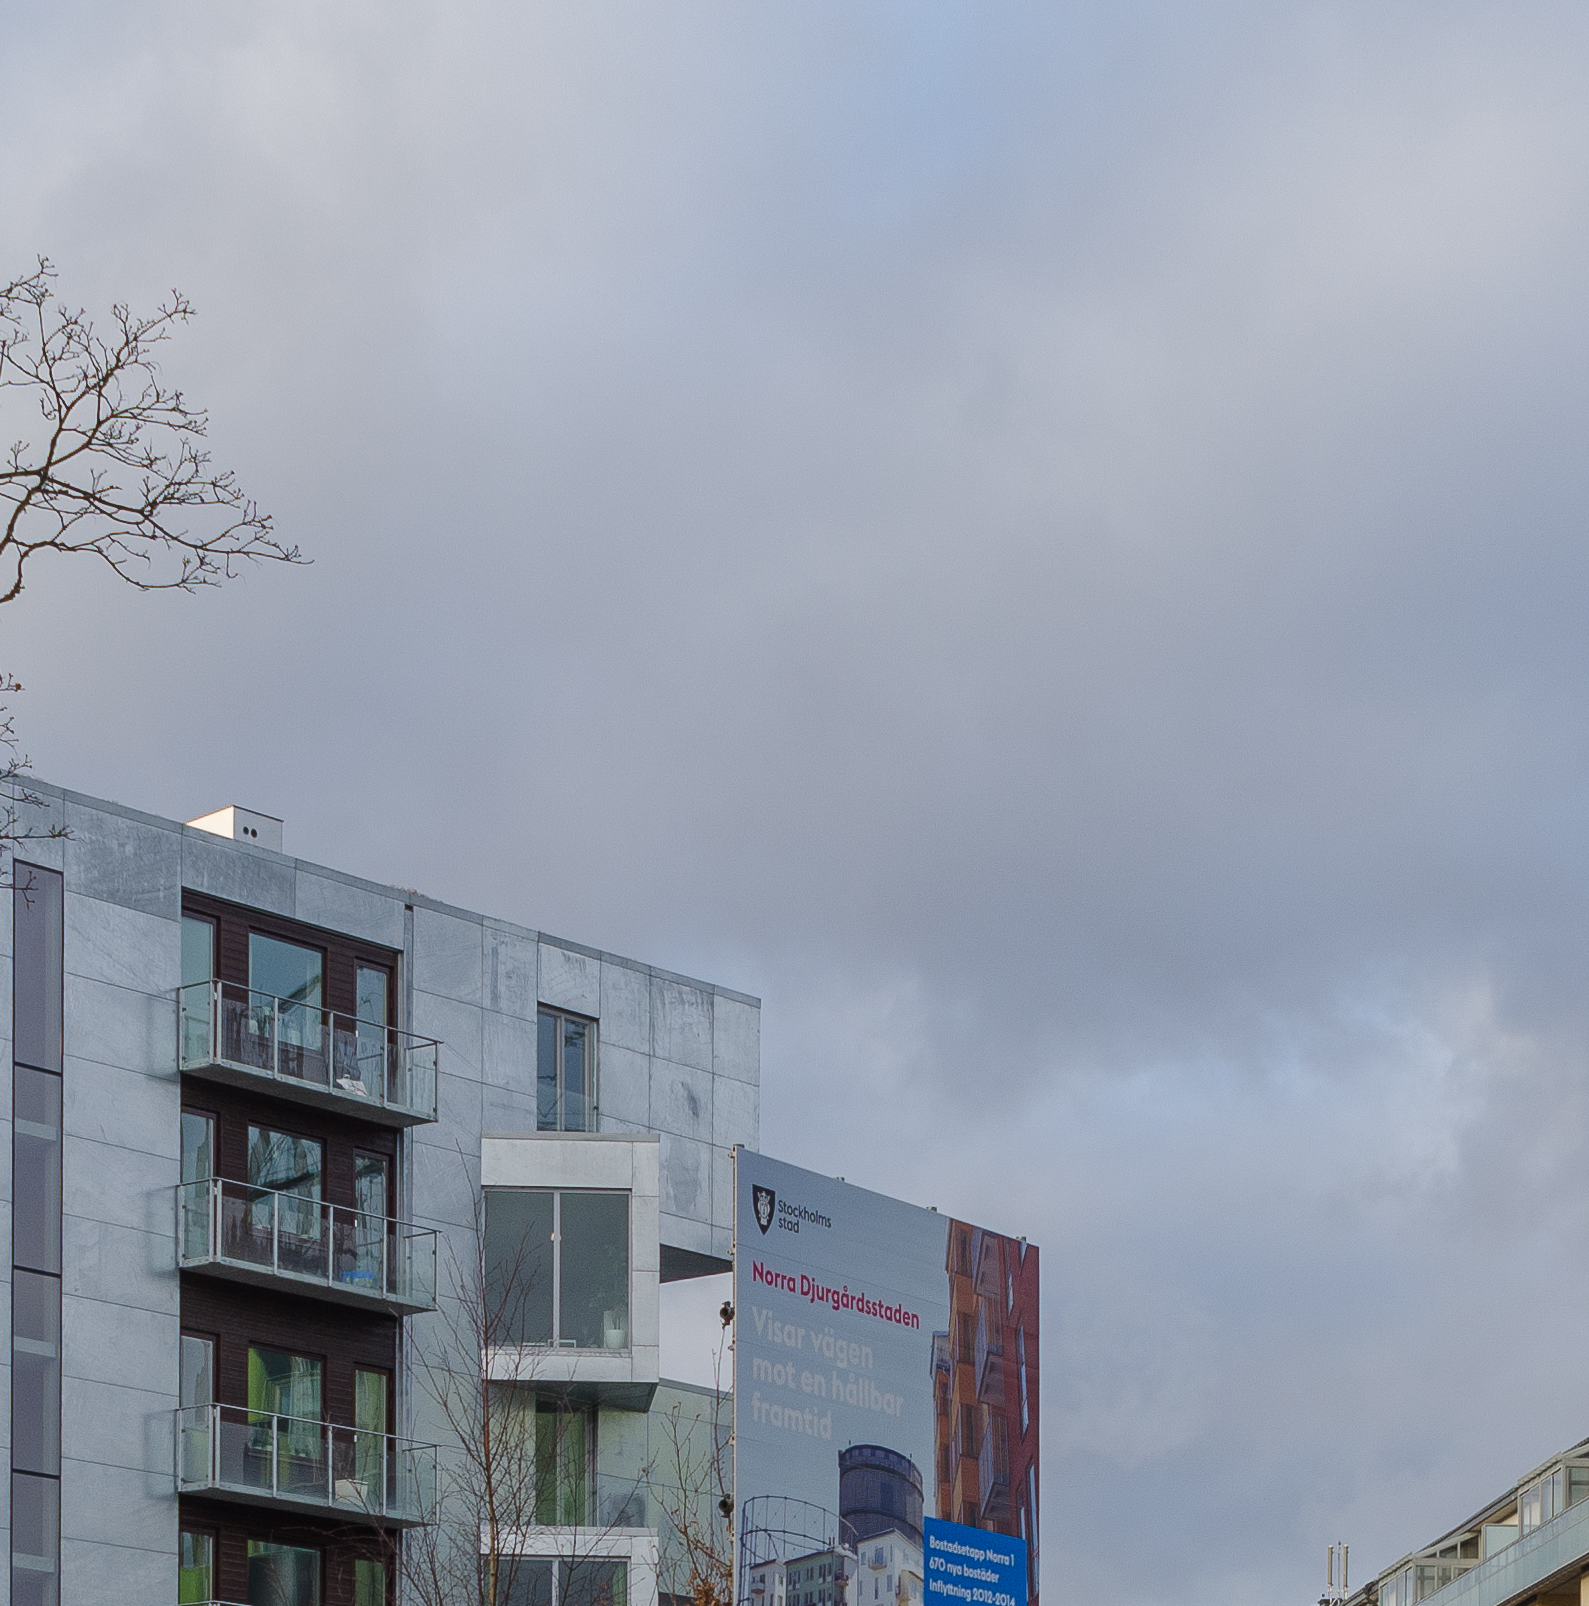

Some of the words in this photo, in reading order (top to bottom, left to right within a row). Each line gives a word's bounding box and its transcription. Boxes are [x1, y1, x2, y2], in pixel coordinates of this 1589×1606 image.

[777, 1199, 832, 1229] Stockholms
[777, 1217, 800, 1234] stad
[751, 1261, 796, 1294] Norra
[800, 1274, 920, 1330] Djurgårdsstaden
[751, 1307, 805, 1349] Visar
[810, 1326, 875, 1370] vägen
[752, 1355, 794, 1391] mot
[801, 1370, 827, 1397] en
[832, 1374, 904, 1418] hållbar
[751, 1393, 832, 1440] framtid
[929, 1535, 985, 1561] Bostadsetapp
[986, 1549, 1010, 1565] Norra
[928, 1556, 946, 1572] 670
[946, 1563, 963, 1577] nya
[963, 1564, 1000, 1584] bostäder
[929, 1578, 972, 1602] Inflyttning
